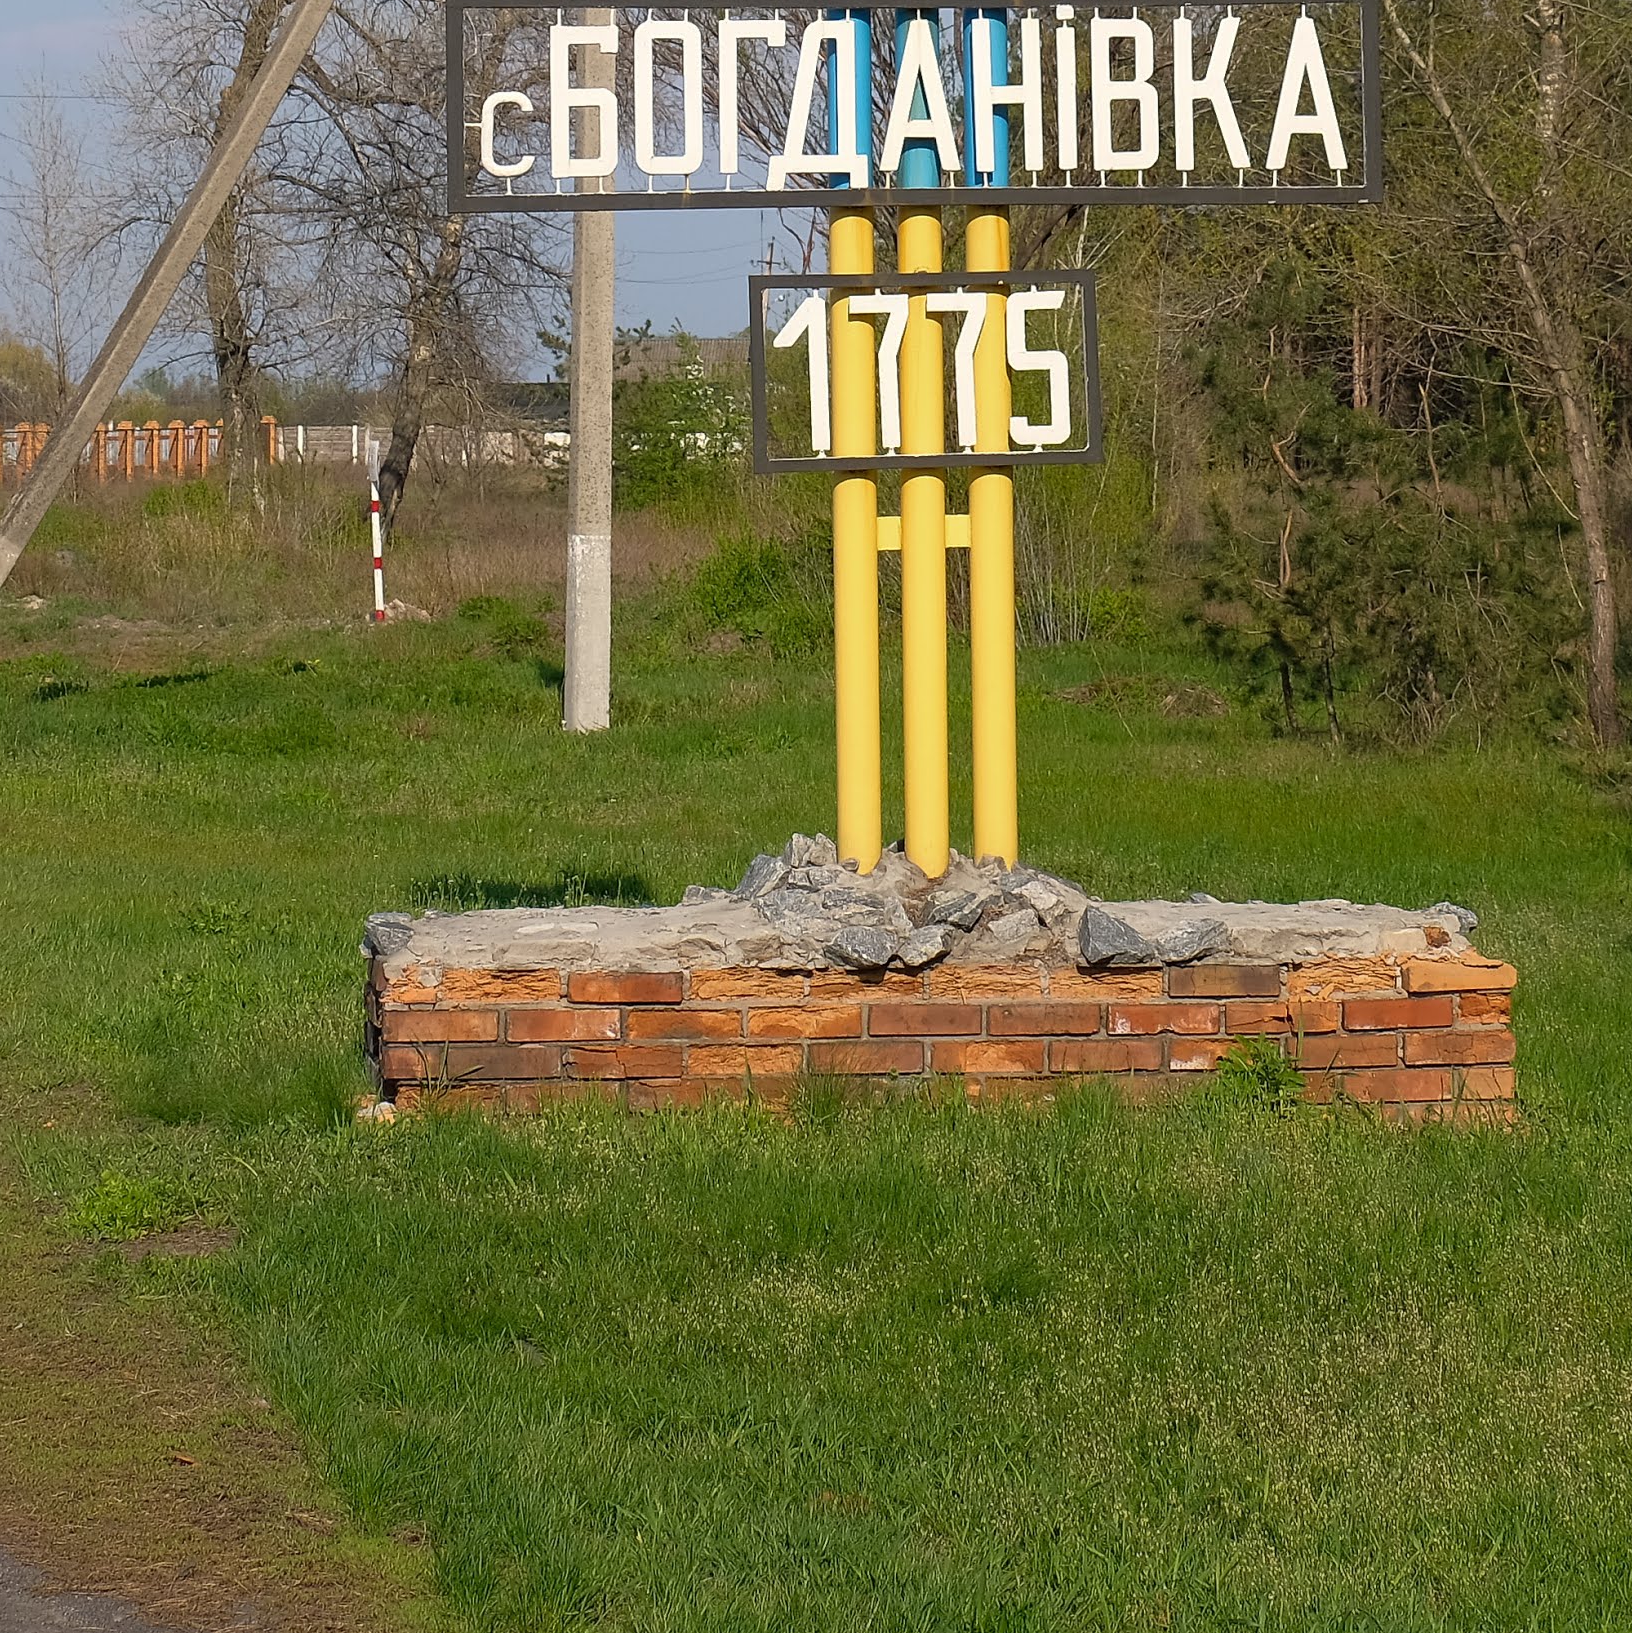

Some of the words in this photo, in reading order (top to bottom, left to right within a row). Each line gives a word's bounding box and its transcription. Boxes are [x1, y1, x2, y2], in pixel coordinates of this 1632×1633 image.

[481, 91, 535, 177] с
[550, 5, 1349, 192] БОГДАНІВКА
[772, 290, 1072, 450] 1775
